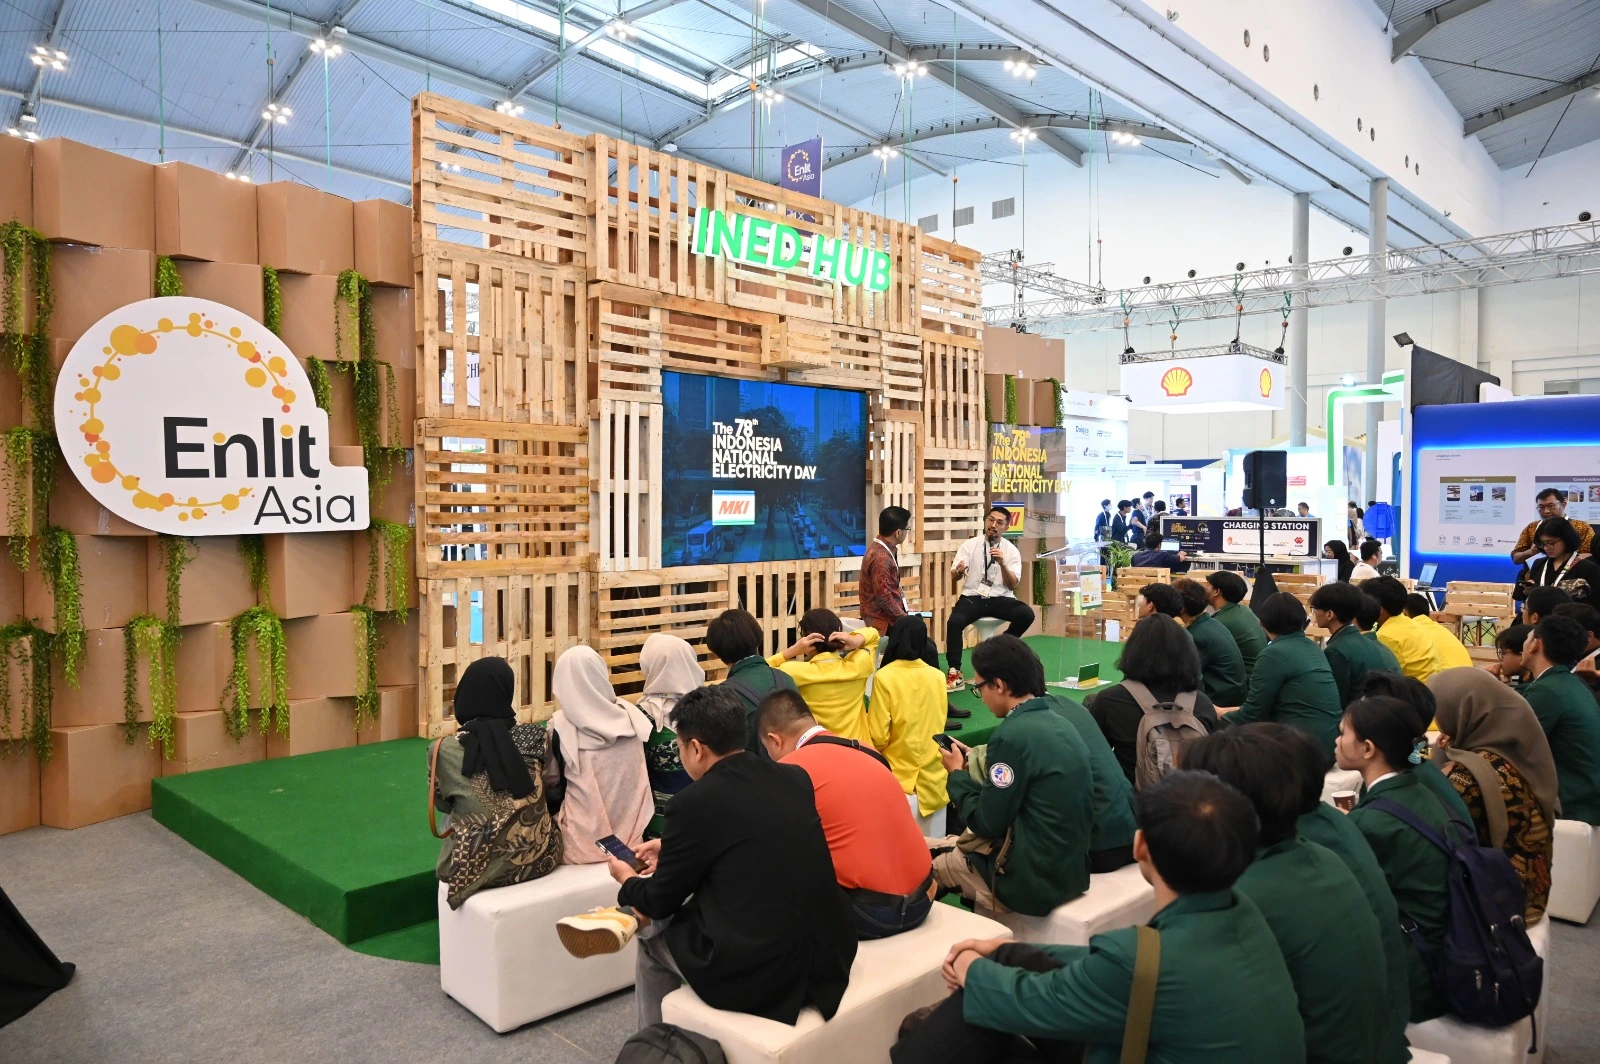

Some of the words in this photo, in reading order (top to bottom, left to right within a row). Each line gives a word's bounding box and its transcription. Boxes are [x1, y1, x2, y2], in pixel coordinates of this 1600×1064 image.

[794, 163, 811, 177] Enlit
[803, 173, 815, 182] Asia
[691, 207, 802, 270] INED
[808, 234, 891, 292] HUB
[712, 421, 734, 435] The
[734, 418, 759, 438] 78th
[163, 417, 320, 479] Enlit
[712, 434, 783, 452] INDONESIA
[994, 433, 1011, 446] The
[712, 448, 778, 465] NATIONAL
[992, 445, 1048, 464] INDONESIA
[712, 462, 793, 479] ELECTRICITY
[794, 465, 817, 480] DAY
[991, 463, 1043, 479] NATIONAL
[991, 478, 1053, 494] ELECTRICITY
[1054, 480, 1073, 494] DAY
[253, 484, 356, 526] Asia
[718, 500, 751, 515] MKI
[1222, 521, 1270, 530] CHARGING
[1271, 522, 1310, 530] STATION
